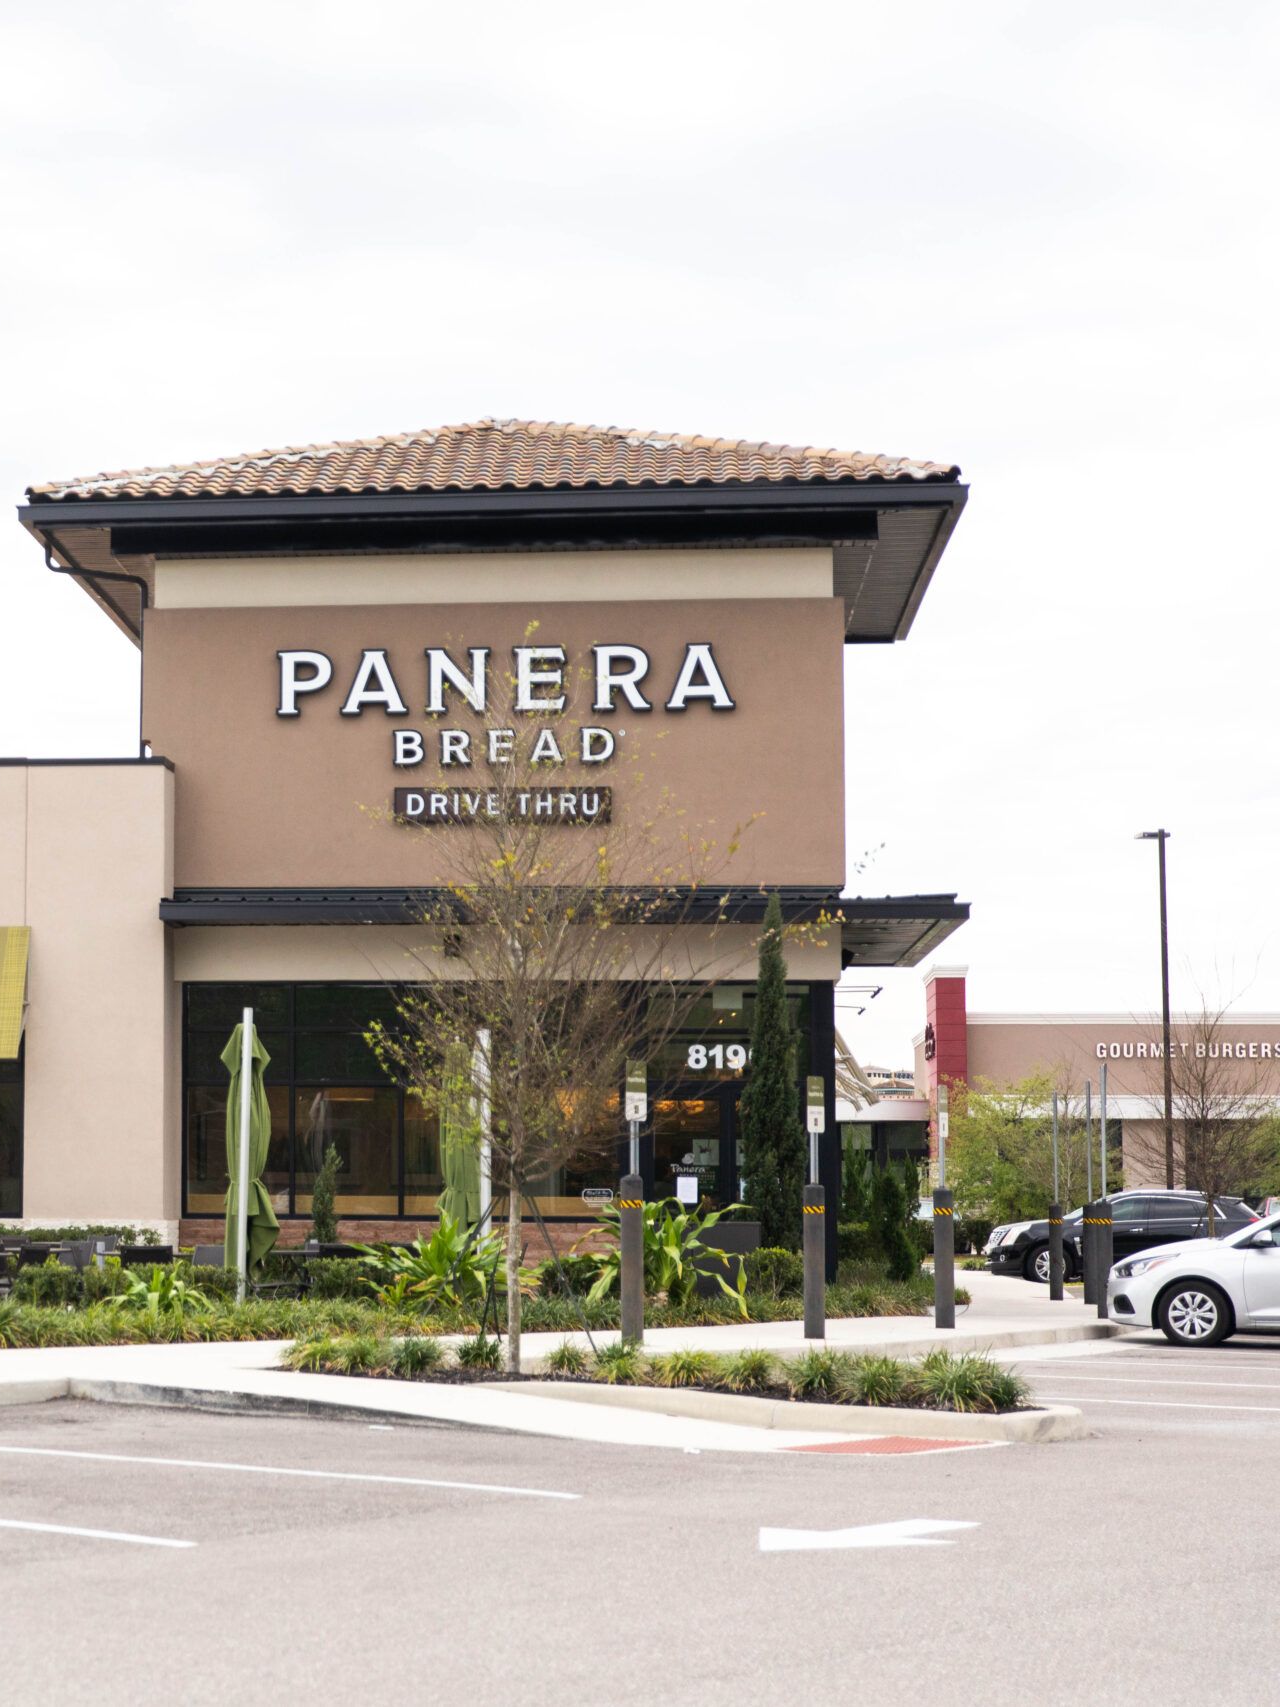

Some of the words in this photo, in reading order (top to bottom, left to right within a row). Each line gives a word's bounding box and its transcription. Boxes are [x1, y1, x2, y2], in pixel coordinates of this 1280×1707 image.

[276, 642, 736, 717] PANERA
[393, 727, 616, 767] BREAD
[405, 792, 502, 817] DRIVE
[517, 792, 601, 817] THRU
[687, 1043, 754, 1070] 819
[1096, 1042, 1189, 1058] GOURMET
